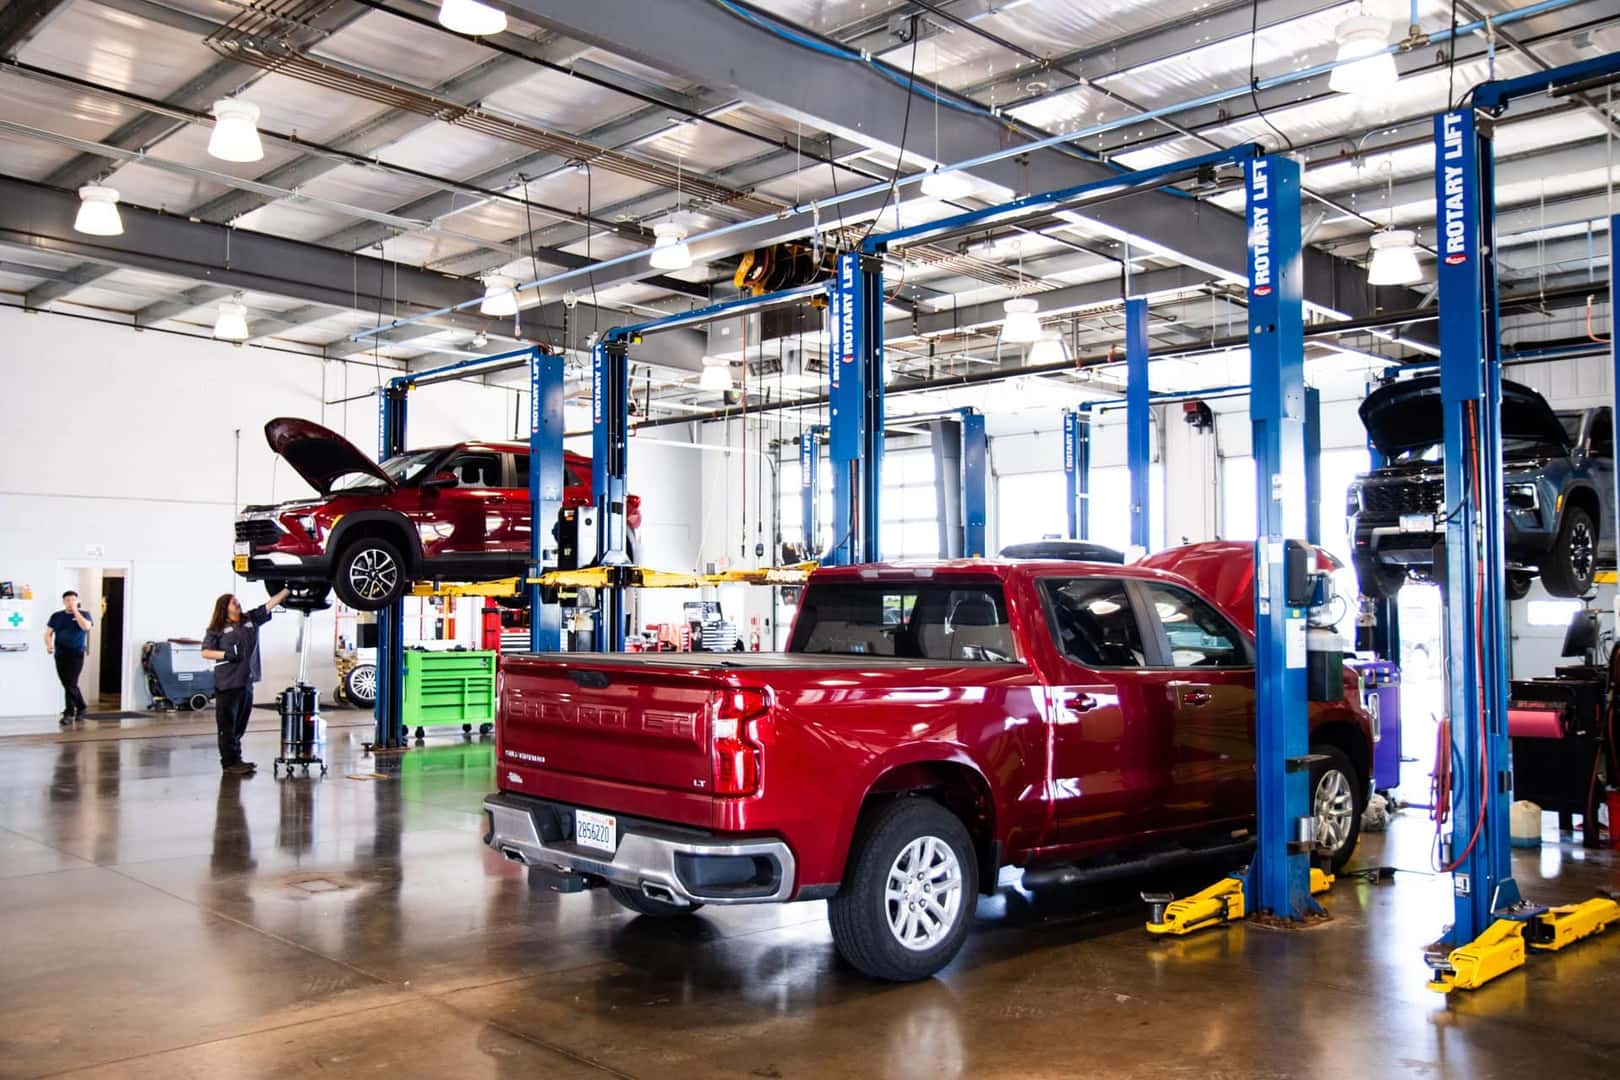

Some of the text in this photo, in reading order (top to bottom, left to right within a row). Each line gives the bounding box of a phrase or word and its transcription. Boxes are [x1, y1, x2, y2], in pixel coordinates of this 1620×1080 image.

[1443, 112, 1463, 160] LIFT
[1252, 160, 1268, 201] LIFT
[1445, 166, 1465, 253] ROTARY
[1253, 206, 1270, 286] ROTARY
[842, 255, 853, 289] LIFT
[843, 292, 853, 355] ROTARY
[594, 344, 602, 368] LIFT
[508, 701, 696, 736] CHEVROLET
[693, 779, 706, 787] LT
